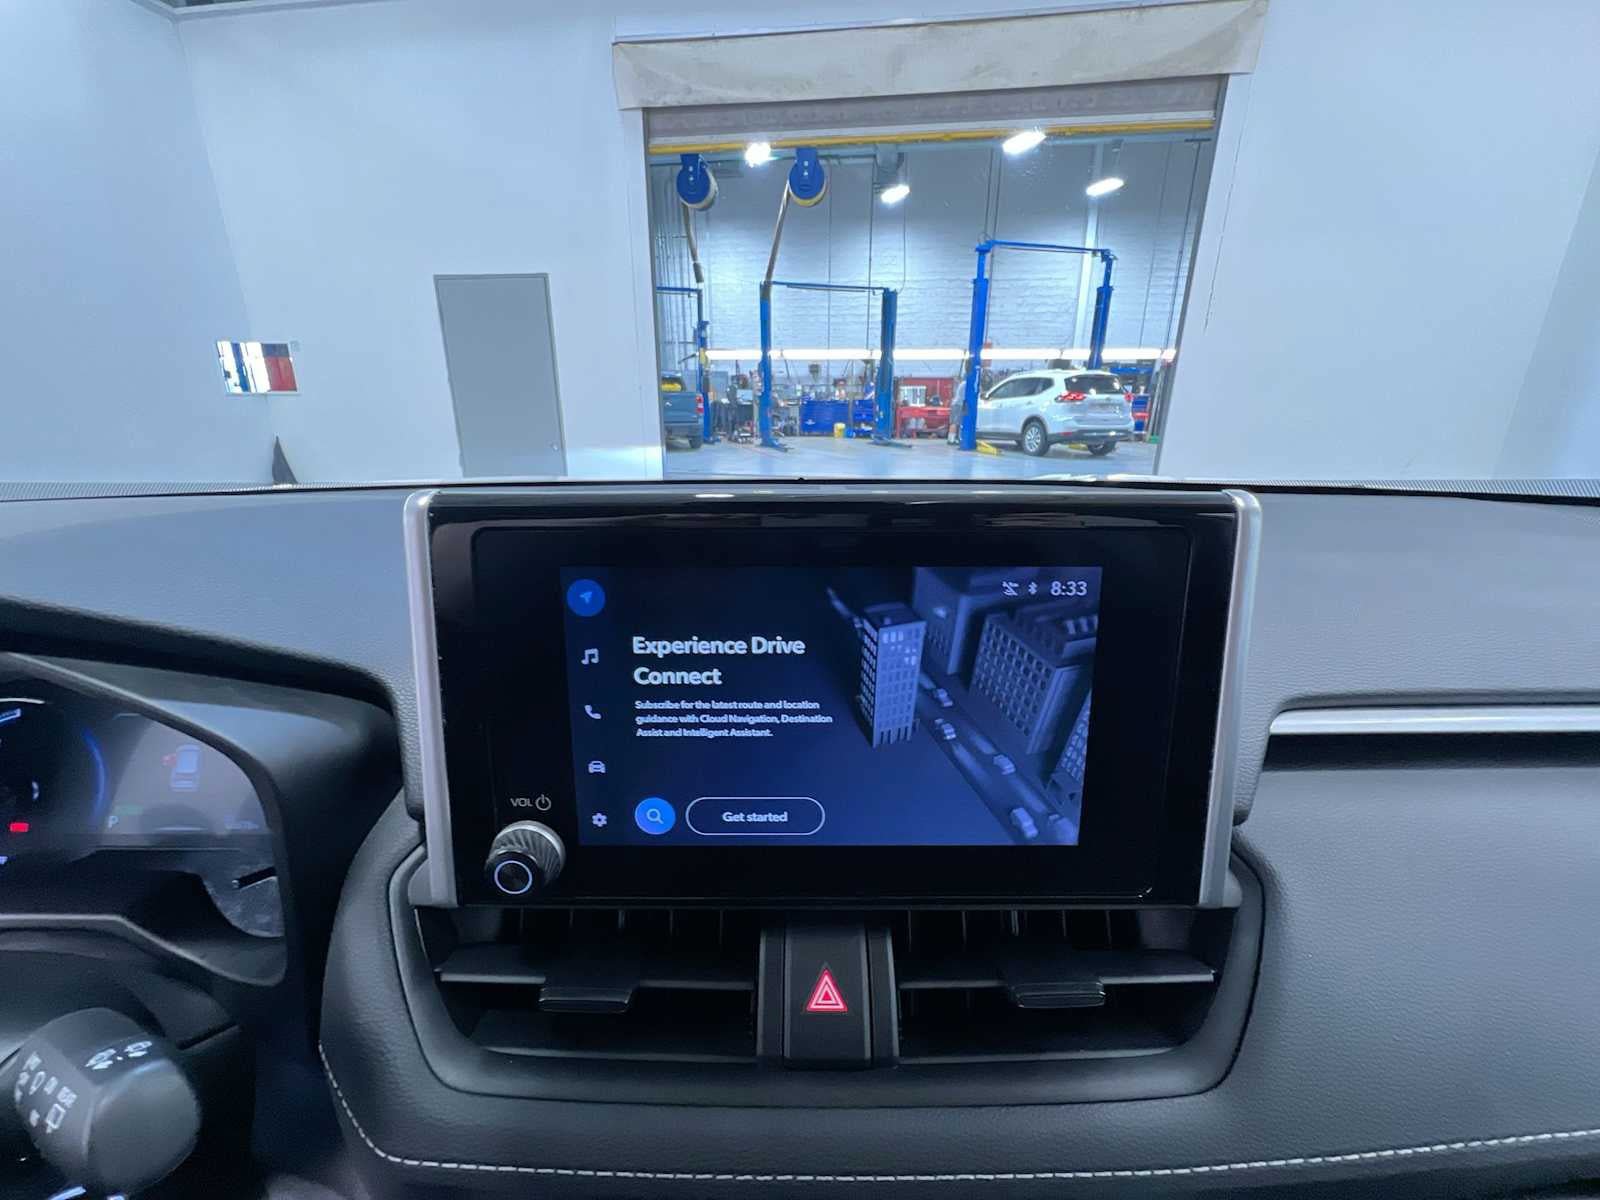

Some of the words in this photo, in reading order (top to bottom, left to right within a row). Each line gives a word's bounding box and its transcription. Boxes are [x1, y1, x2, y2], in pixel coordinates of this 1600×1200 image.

[1050, 580, 1088, 596] 8:33
[632, 635, 748, 658] Experience
[751, 635, 806, 655] Drive
[633, 666, 723, 686] Connect
[634, 700, 680, 710] Subscribe
[680, 700, 694, 710] for
[694, 700, 711, 710] the
[711, 700, 738, 710] latest
[739, 701, 763, 710] route
[764, 700, 782, 710] and
[783, 700, 820, 710] location
[635, 714, 678, 725] guidance
[678, 714, 699, 723] with
[699, 714, 728, 723] Cloud
[728, 714, 780, 725] Navigation,
[780, 714, 833, 723] Destination
[636, 728, 663, 737] Assist
[663, 728, 682, 737] and
[682, 728, 729, 739] Intelligent
[729, 728, 774, 737] Assistant.
[510, 798, 533, 807] VOL
[722, 811, 745, 822] Get
[746, 811, 788, 822] started
